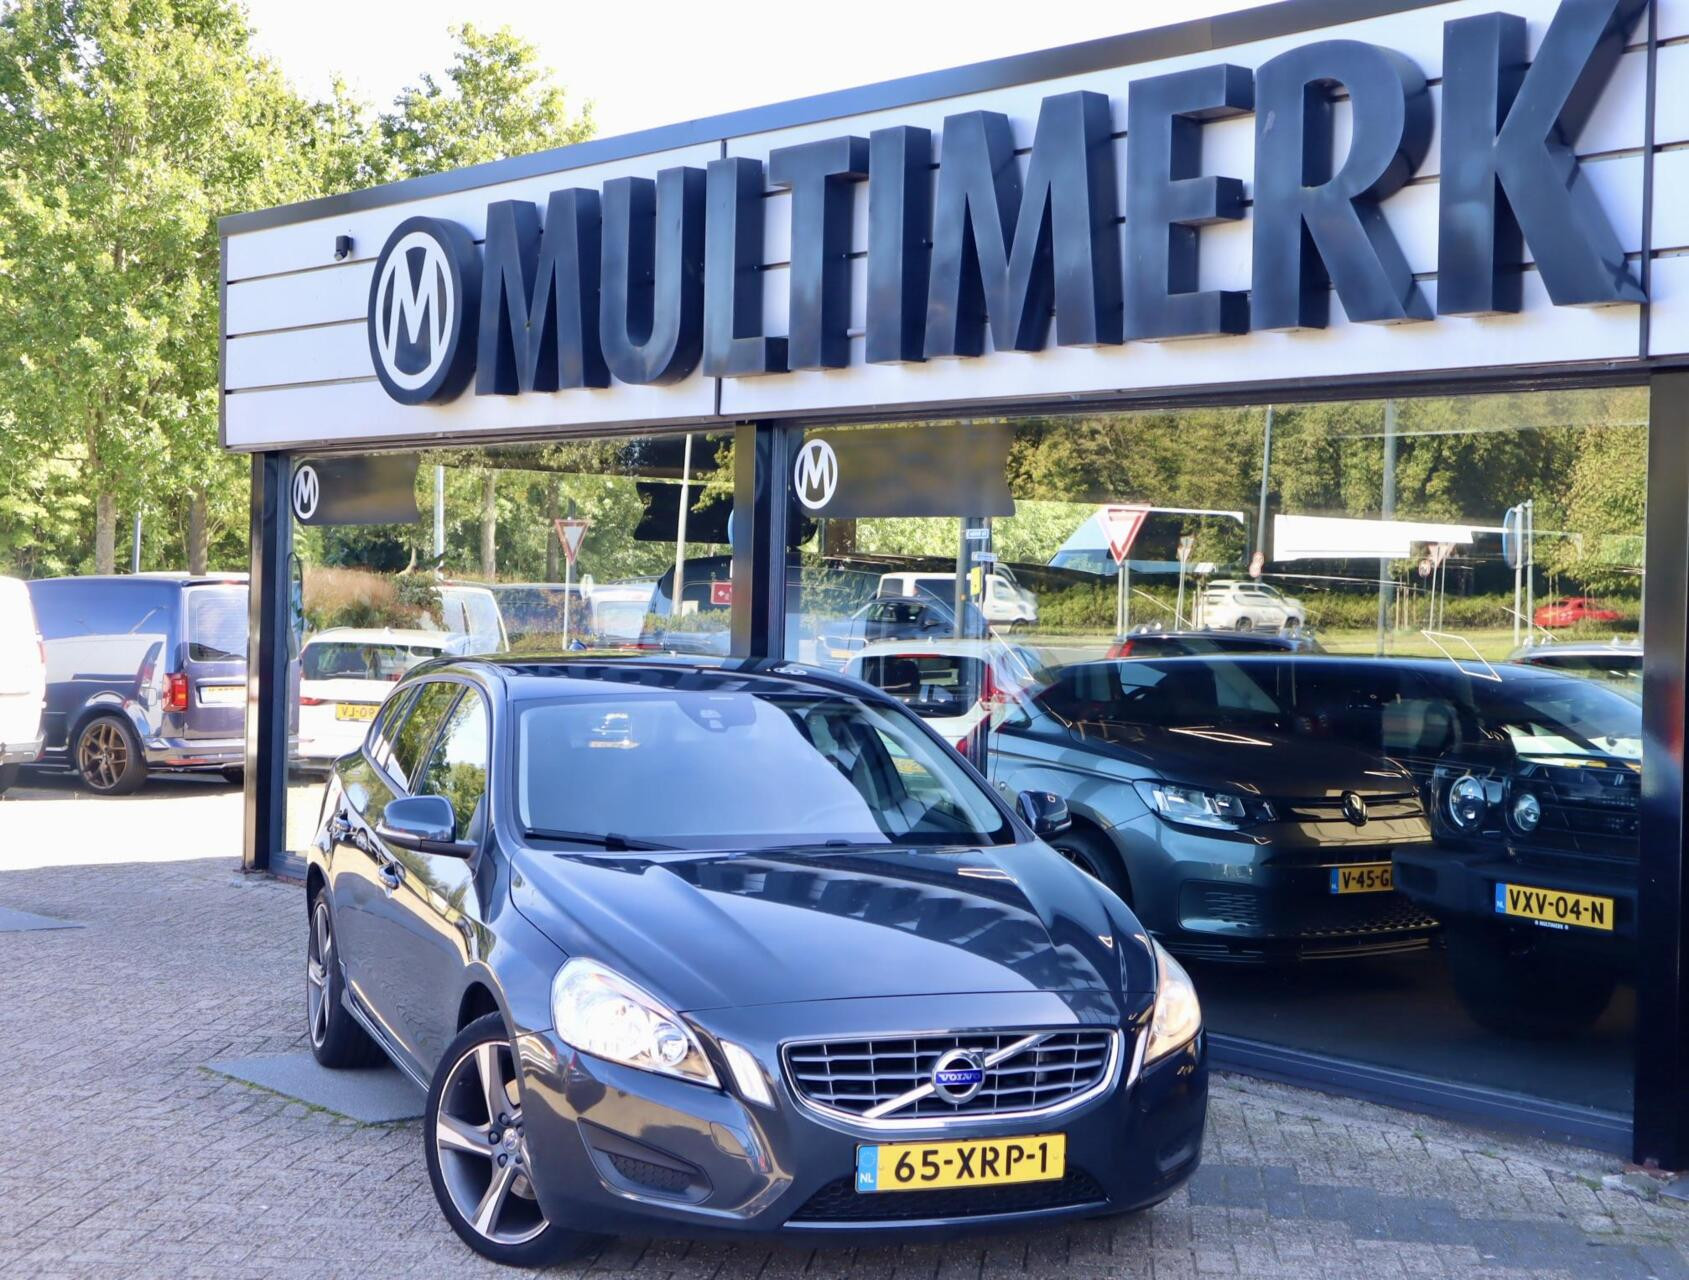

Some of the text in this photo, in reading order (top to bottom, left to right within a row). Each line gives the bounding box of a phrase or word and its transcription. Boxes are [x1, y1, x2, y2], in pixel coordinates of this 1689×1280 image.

[475, 0, 1648, 393] MULTIMERK
[1342, 869, 1392, 889] V-45-G
[1509, 888, 1604, 924] VXV-04-N
[938, 1073, 980, 1082] VOLVO
[860, 1142, 1048, 1184] NL 65-XRP-1
